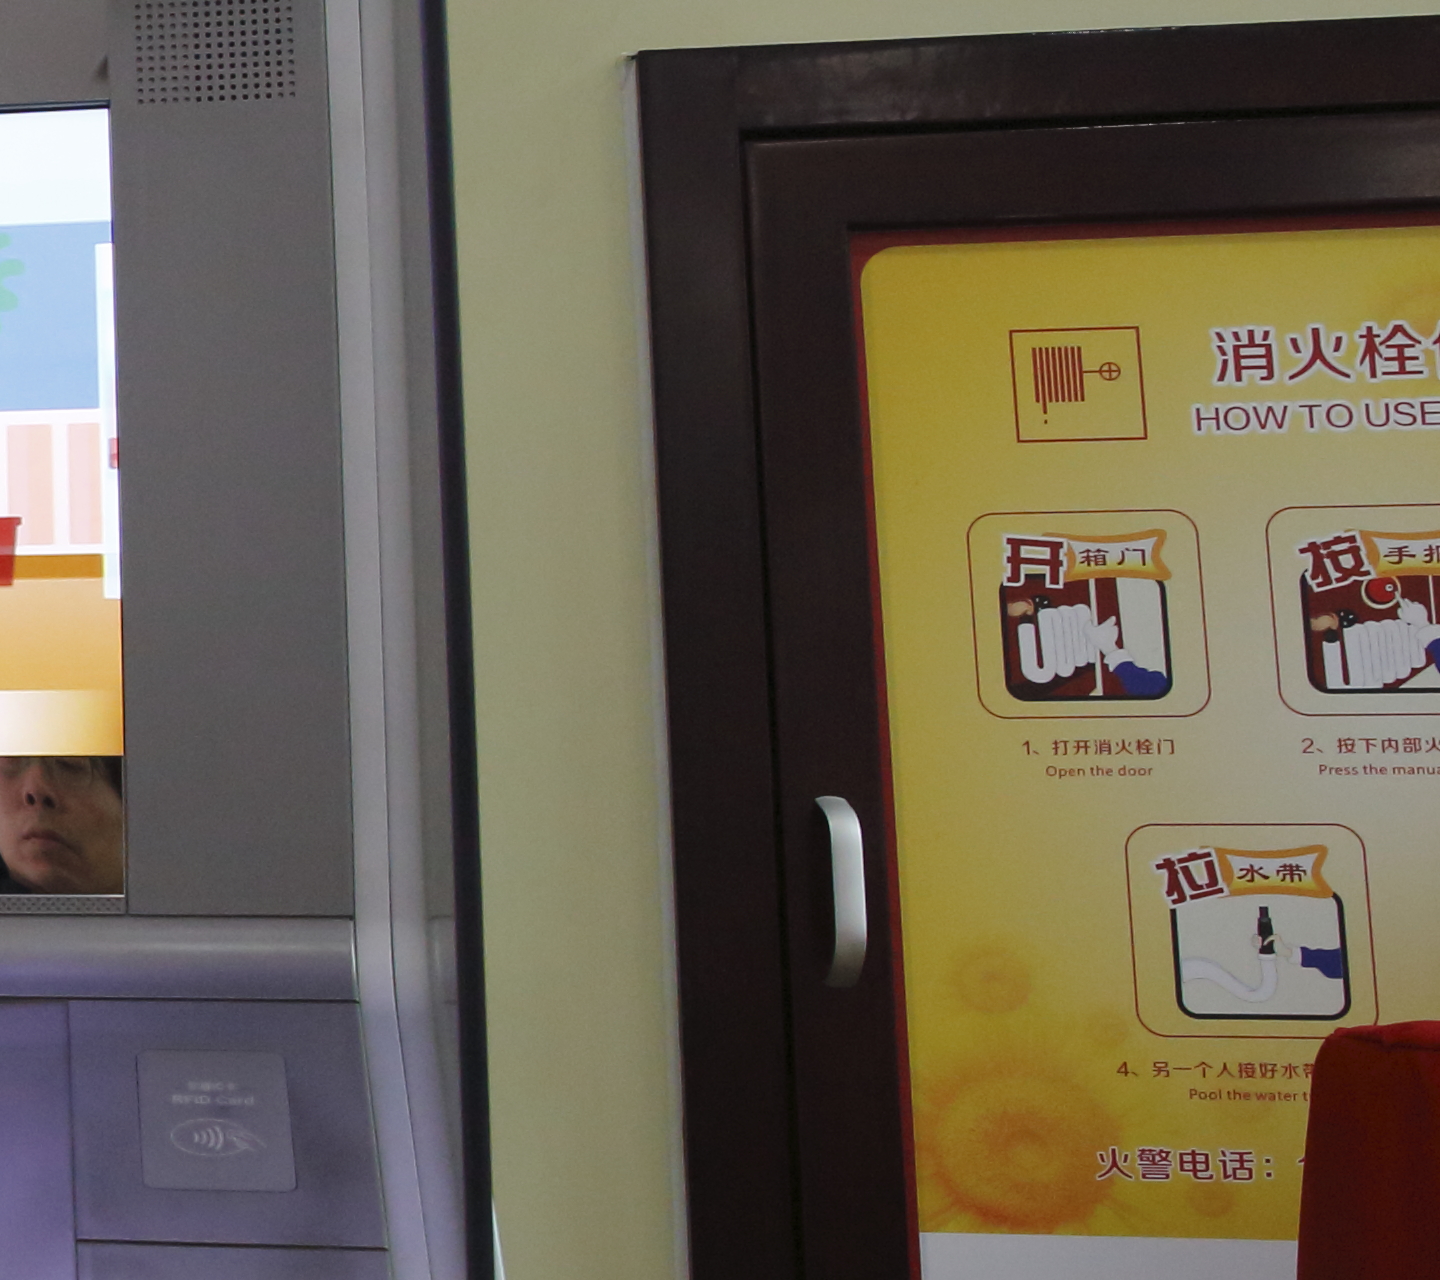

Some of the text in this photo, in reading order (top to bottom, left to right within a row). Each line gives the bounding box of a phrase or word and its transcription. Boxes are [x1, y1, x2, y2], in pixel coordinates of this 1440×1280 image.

[1214, 323, 1440, 383] 消火栓
[1194, 404, 1288, 433] HOW
[1298, 402, 1355, 429] TO
[1005, 535, 1148, 586] 开 箱门
[1298, 534, 1372, 589] 按
[1045, 763, 1154, 779] Open the door
[1318, 764, 1359, 775] Press
[1362, 764, 1388, 775] the
[1156, 851, 1308, 907] 拉 水带
[1189, 1088, 1222, 1100] Pool
[1227, 1089, 1251, 1101] the
[1255, 1090, 1297, 1102] water
